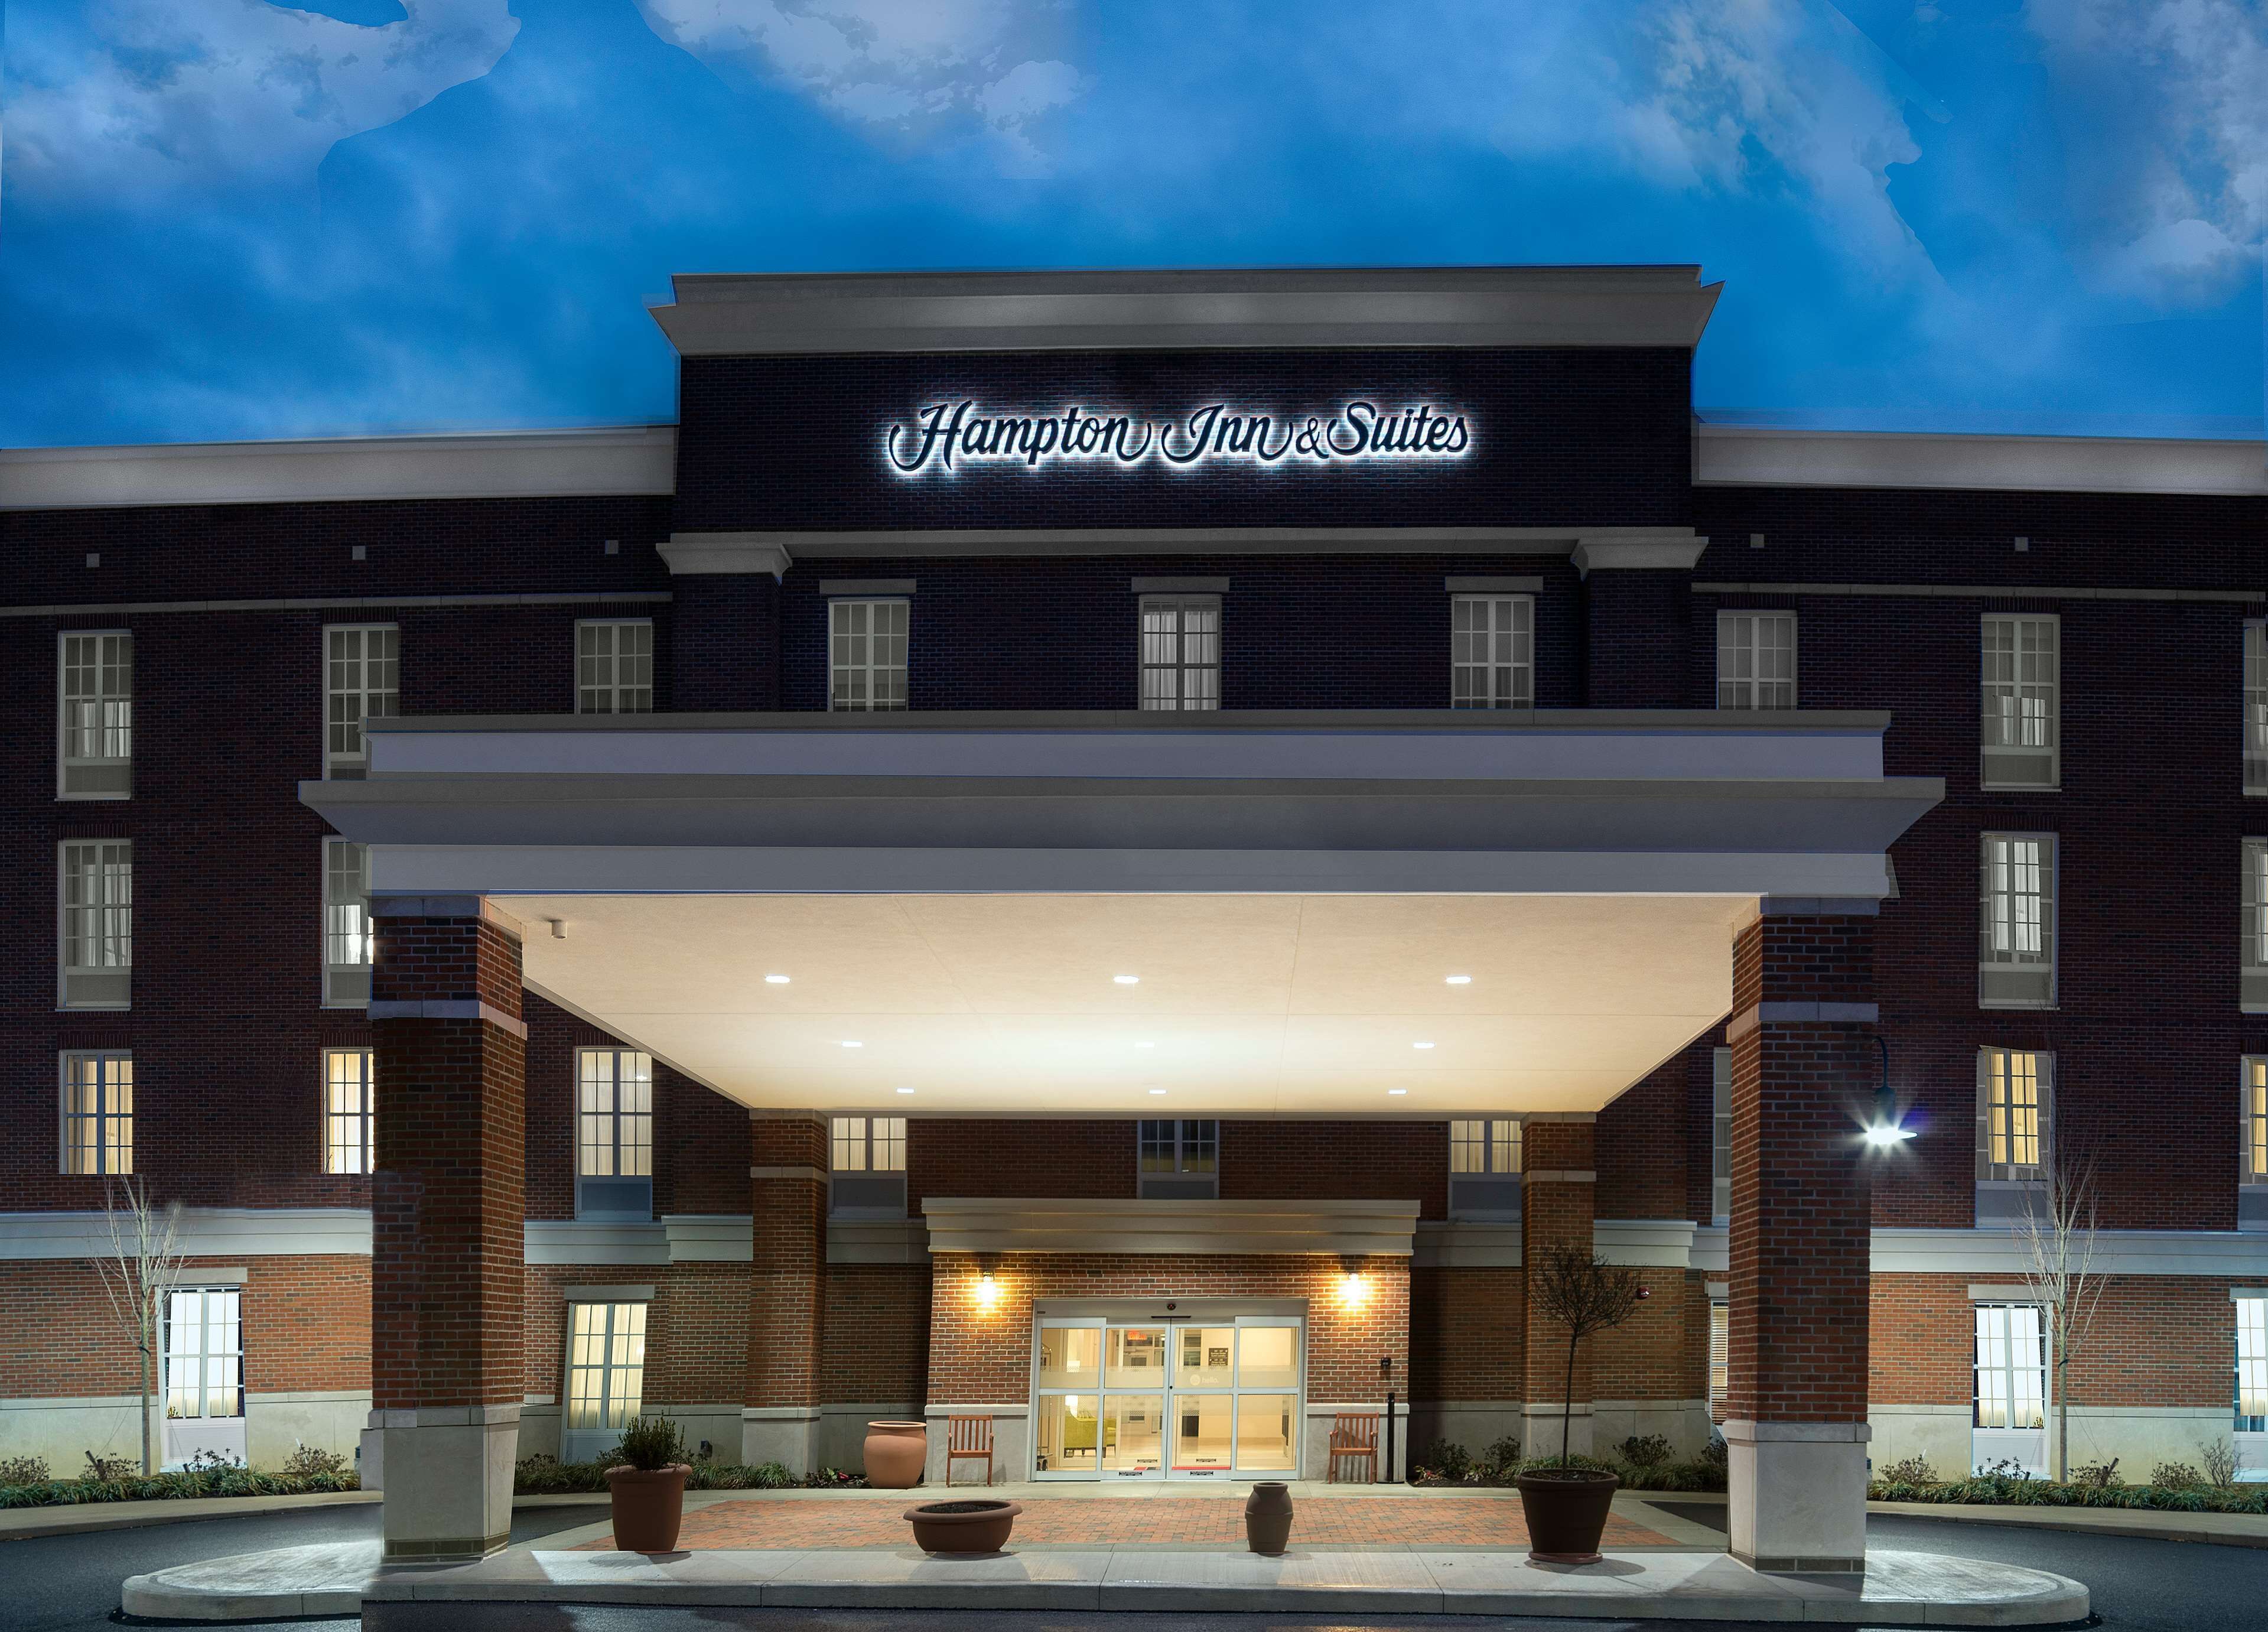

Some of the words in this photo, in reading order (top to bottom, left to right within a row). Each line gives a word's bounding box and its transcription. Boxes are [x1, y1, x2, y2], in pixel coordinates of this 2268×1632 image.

[889, 400, 1151, 472] Hampton
[1161, 404, 1294, 463] Inn
[1296, 417, 1329, 459] &
[1327, 401, 1469, 456] Suites
